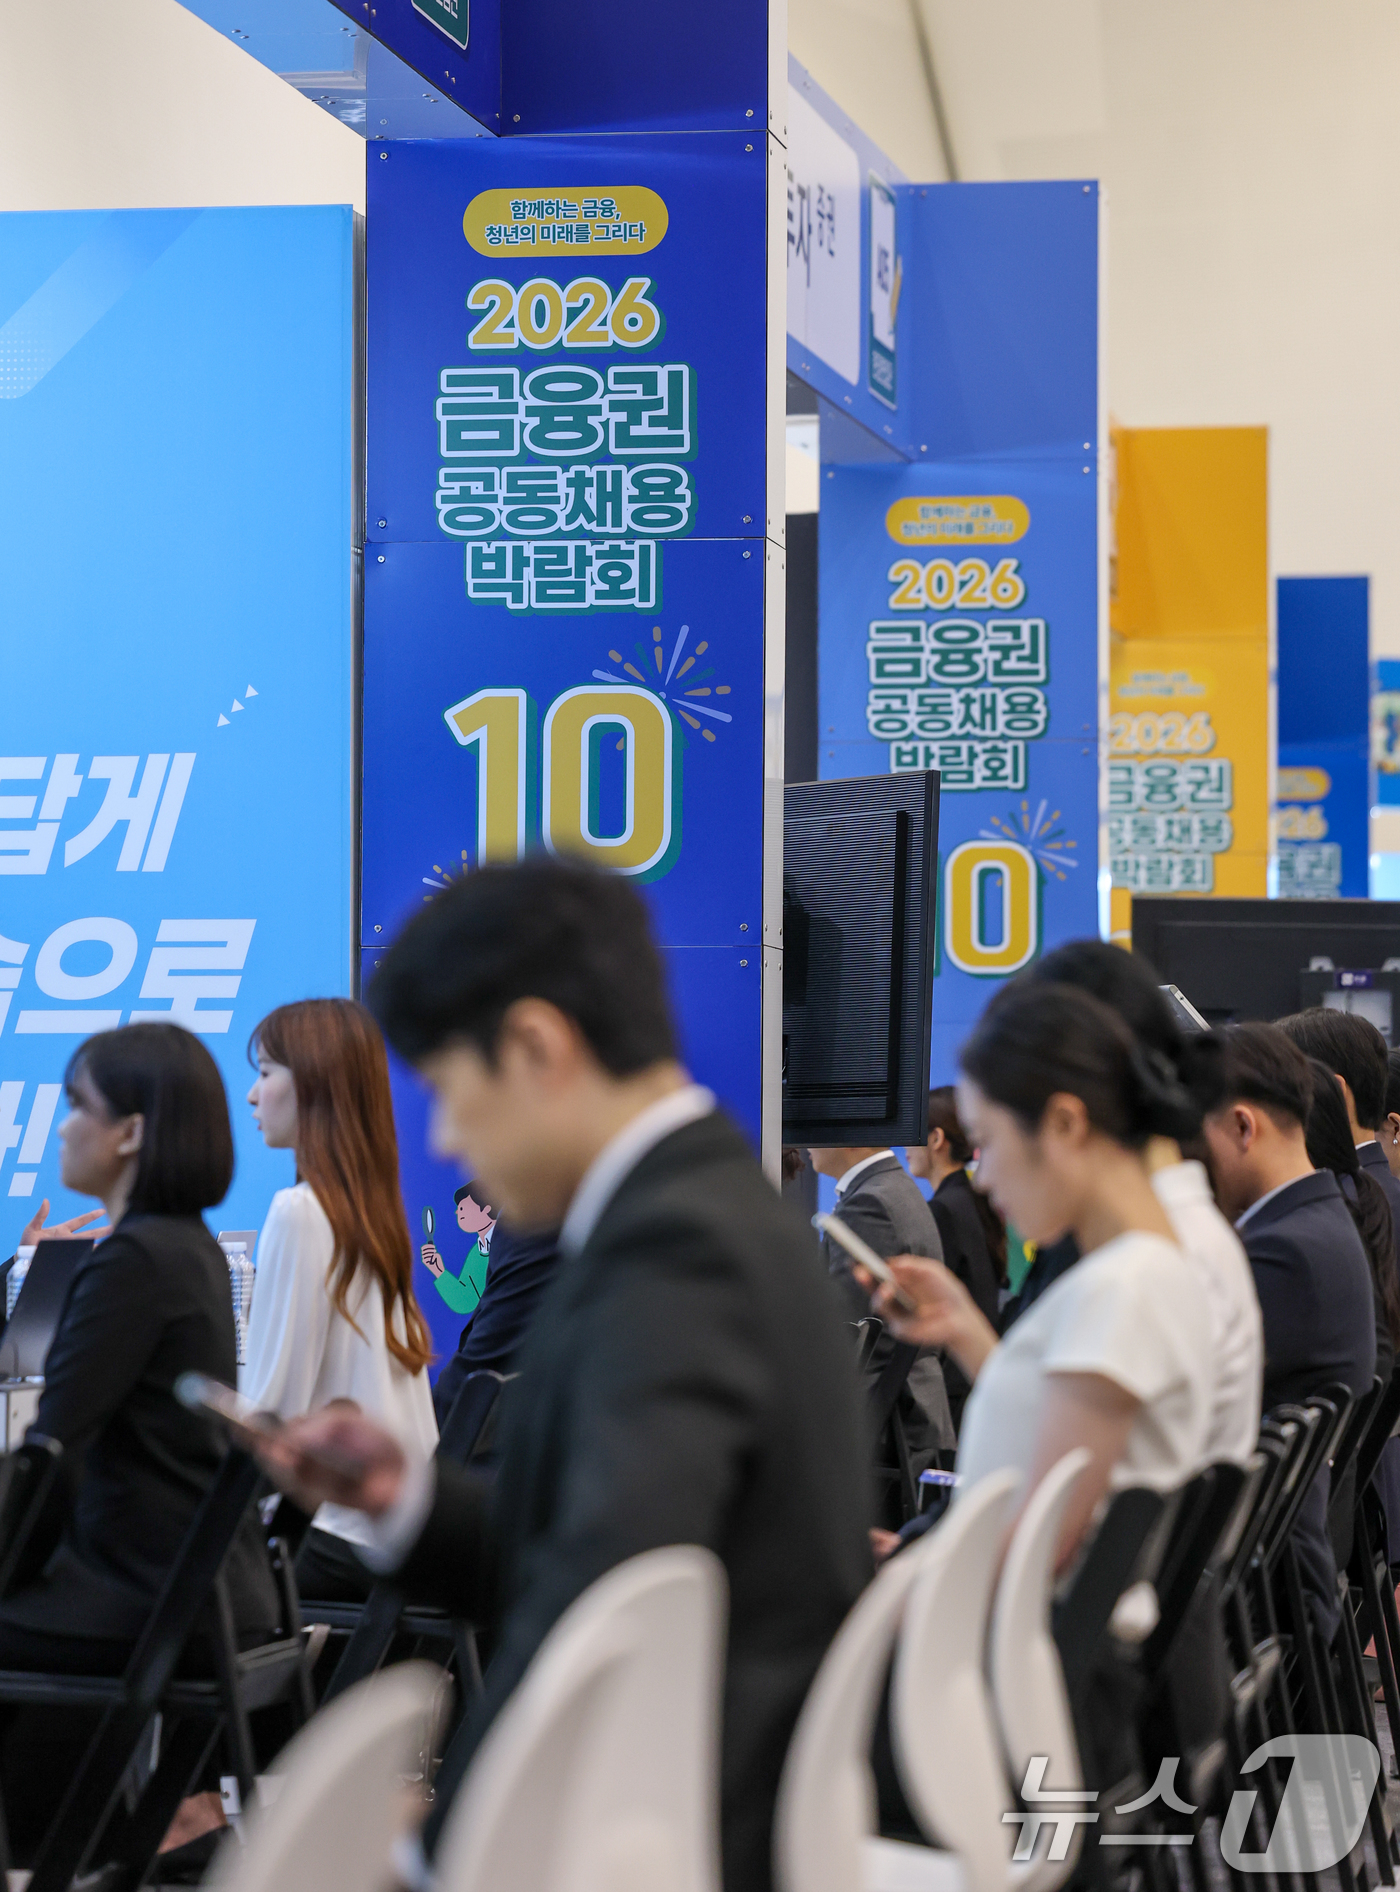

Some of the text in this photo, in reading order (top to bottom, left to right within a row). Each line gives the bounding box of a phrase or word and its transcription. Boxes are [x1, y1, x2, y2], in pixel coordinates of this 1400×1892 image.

[485, 222, 646, 245] 청년의 미래를 그리다
[510, 197, 621, 221] 함께하는 금융,
[466, 277, 660, 350] 2026
[434, 364, 692, 458] 금융권
[435, 463, 691, 536] 공동채용
[467, 540, 656, 610] 박람회
[888, 558, 1026, 610] 2026
[867, 618, 1046, 685] 금융권
[867, 687, 1047, 738] 공동채용
[1108, 711, 1215, 754] 2026
[444, 684, 673, 876] 10
[945, 840, 1037, 975] 0
[0, 917, 257, 1037] 으로
